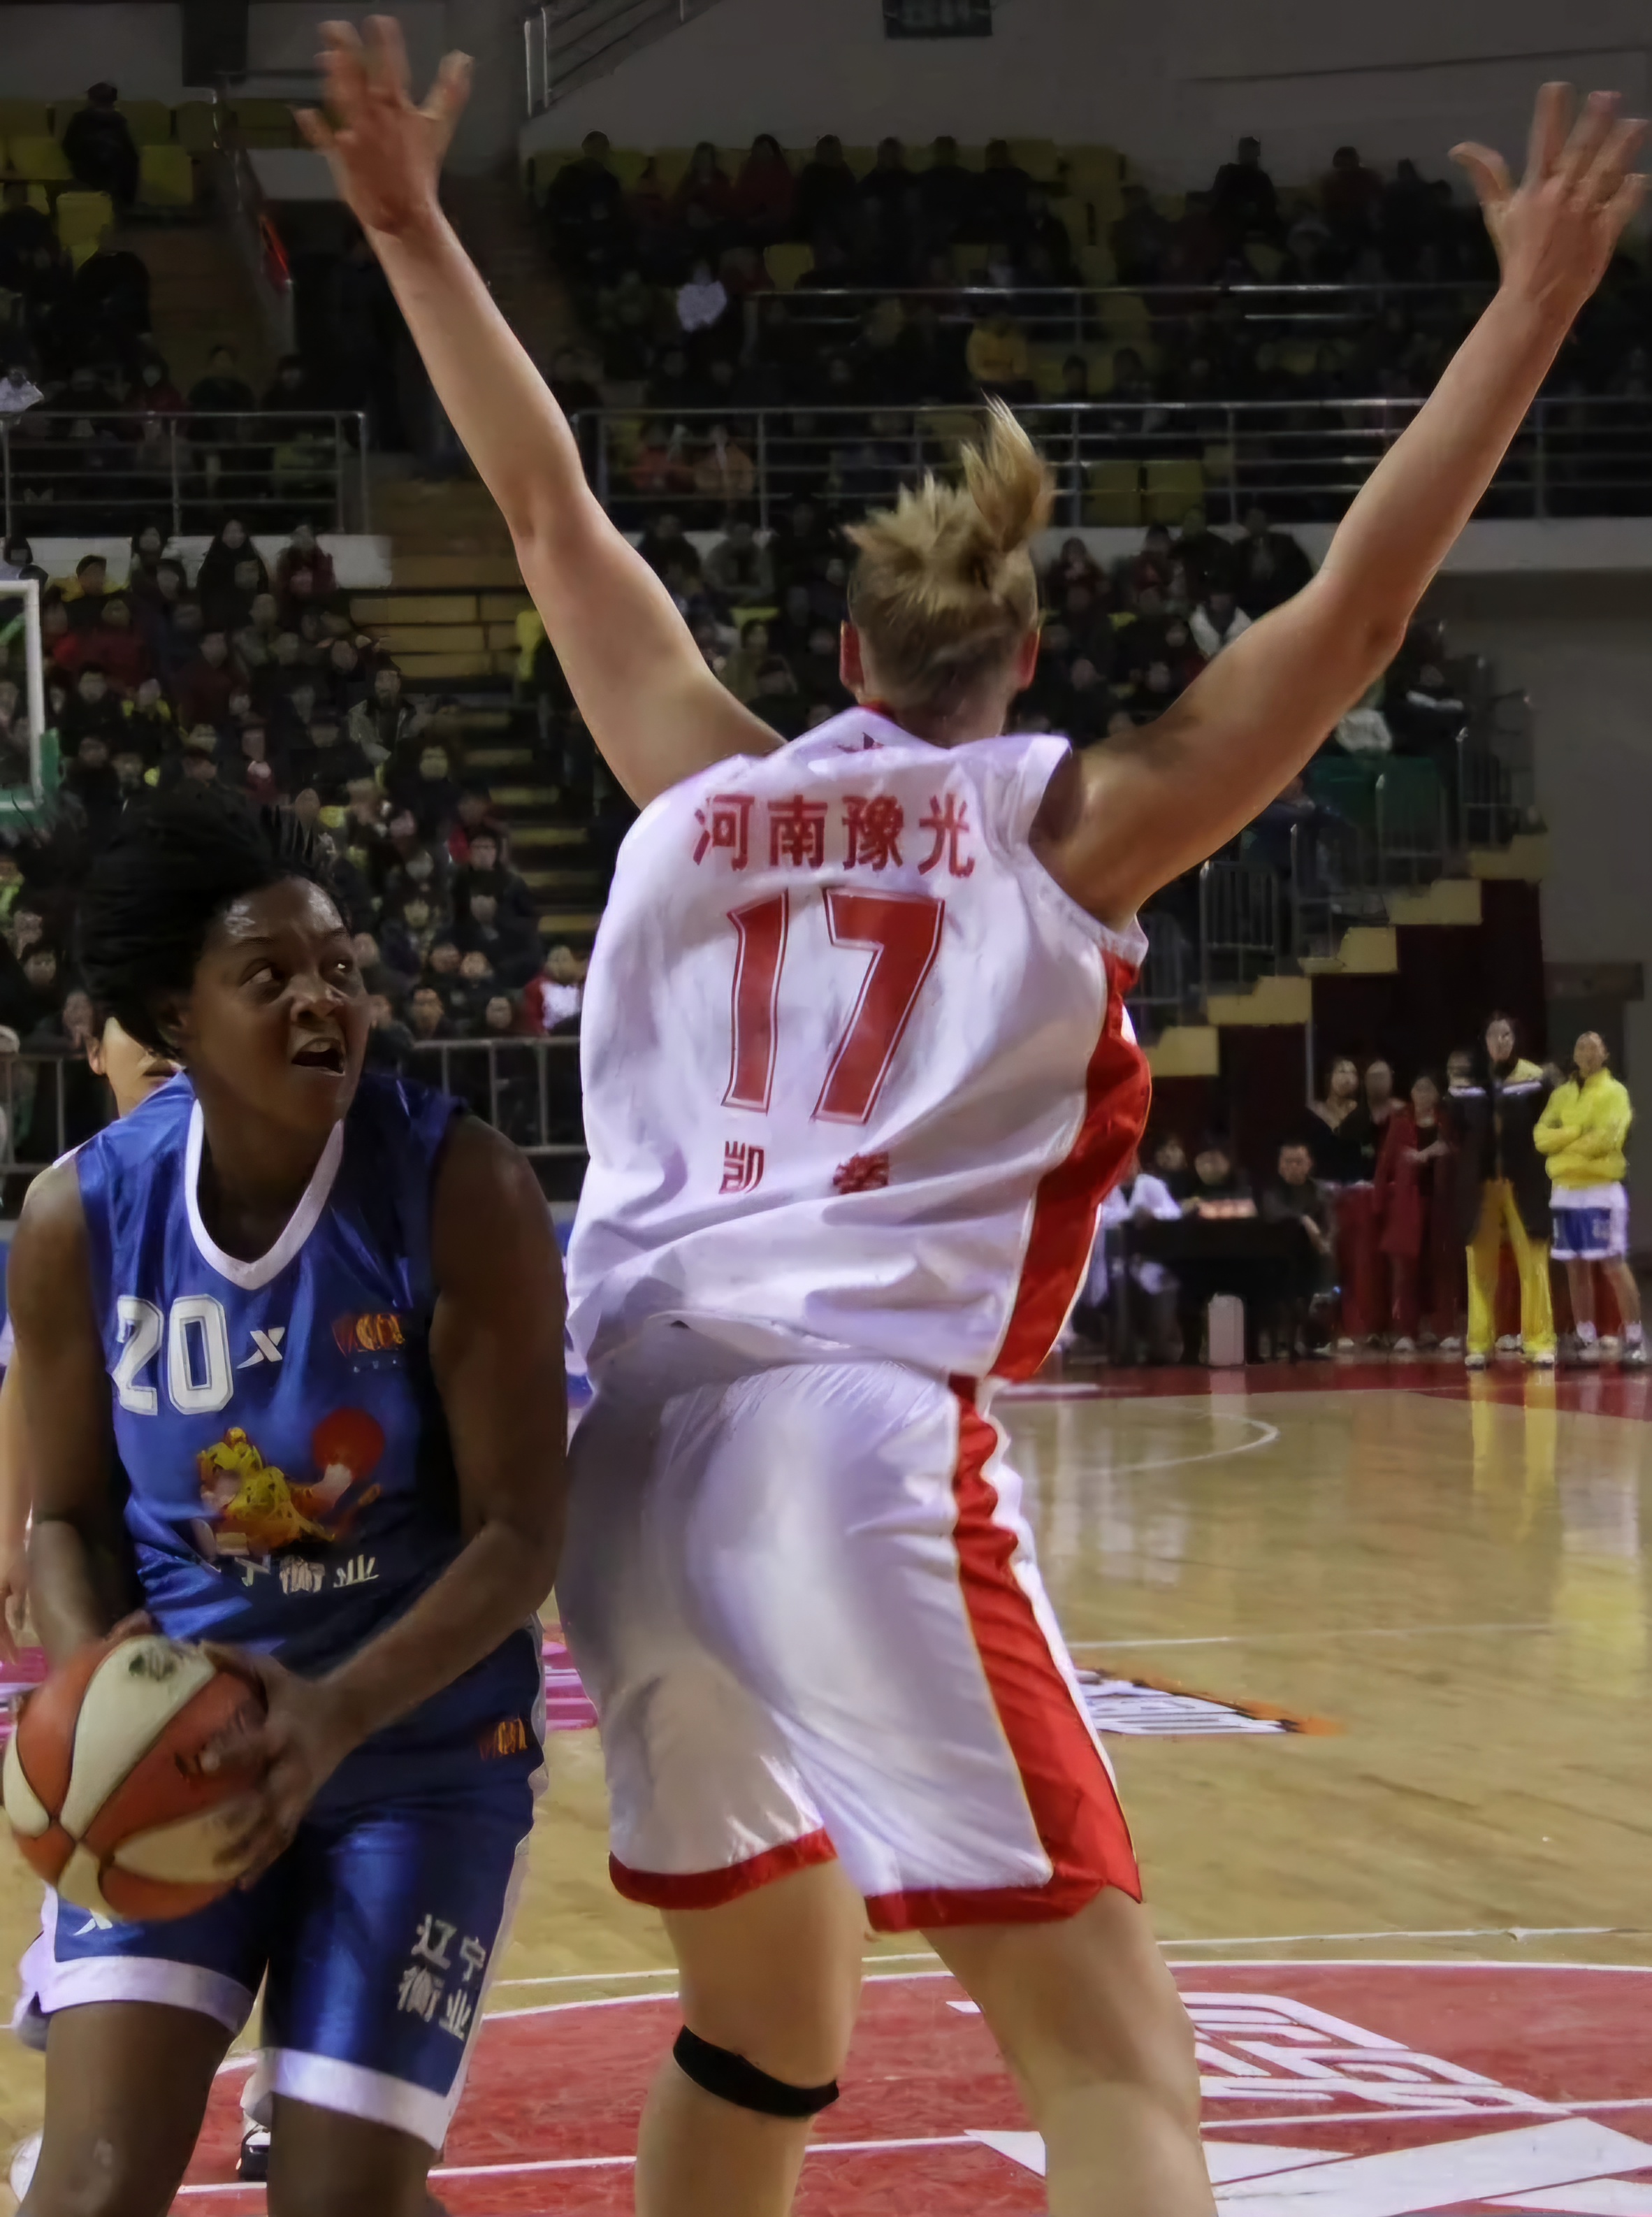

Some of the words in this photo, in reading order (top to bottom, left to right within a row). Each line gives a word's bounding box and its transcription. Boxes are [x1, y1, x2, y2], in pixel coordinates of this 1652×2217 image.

[693, 794, 975, 878] 河南豫光
[720, 886, 945, 1125] 17
[110, 1294, 234, 1416] 20
